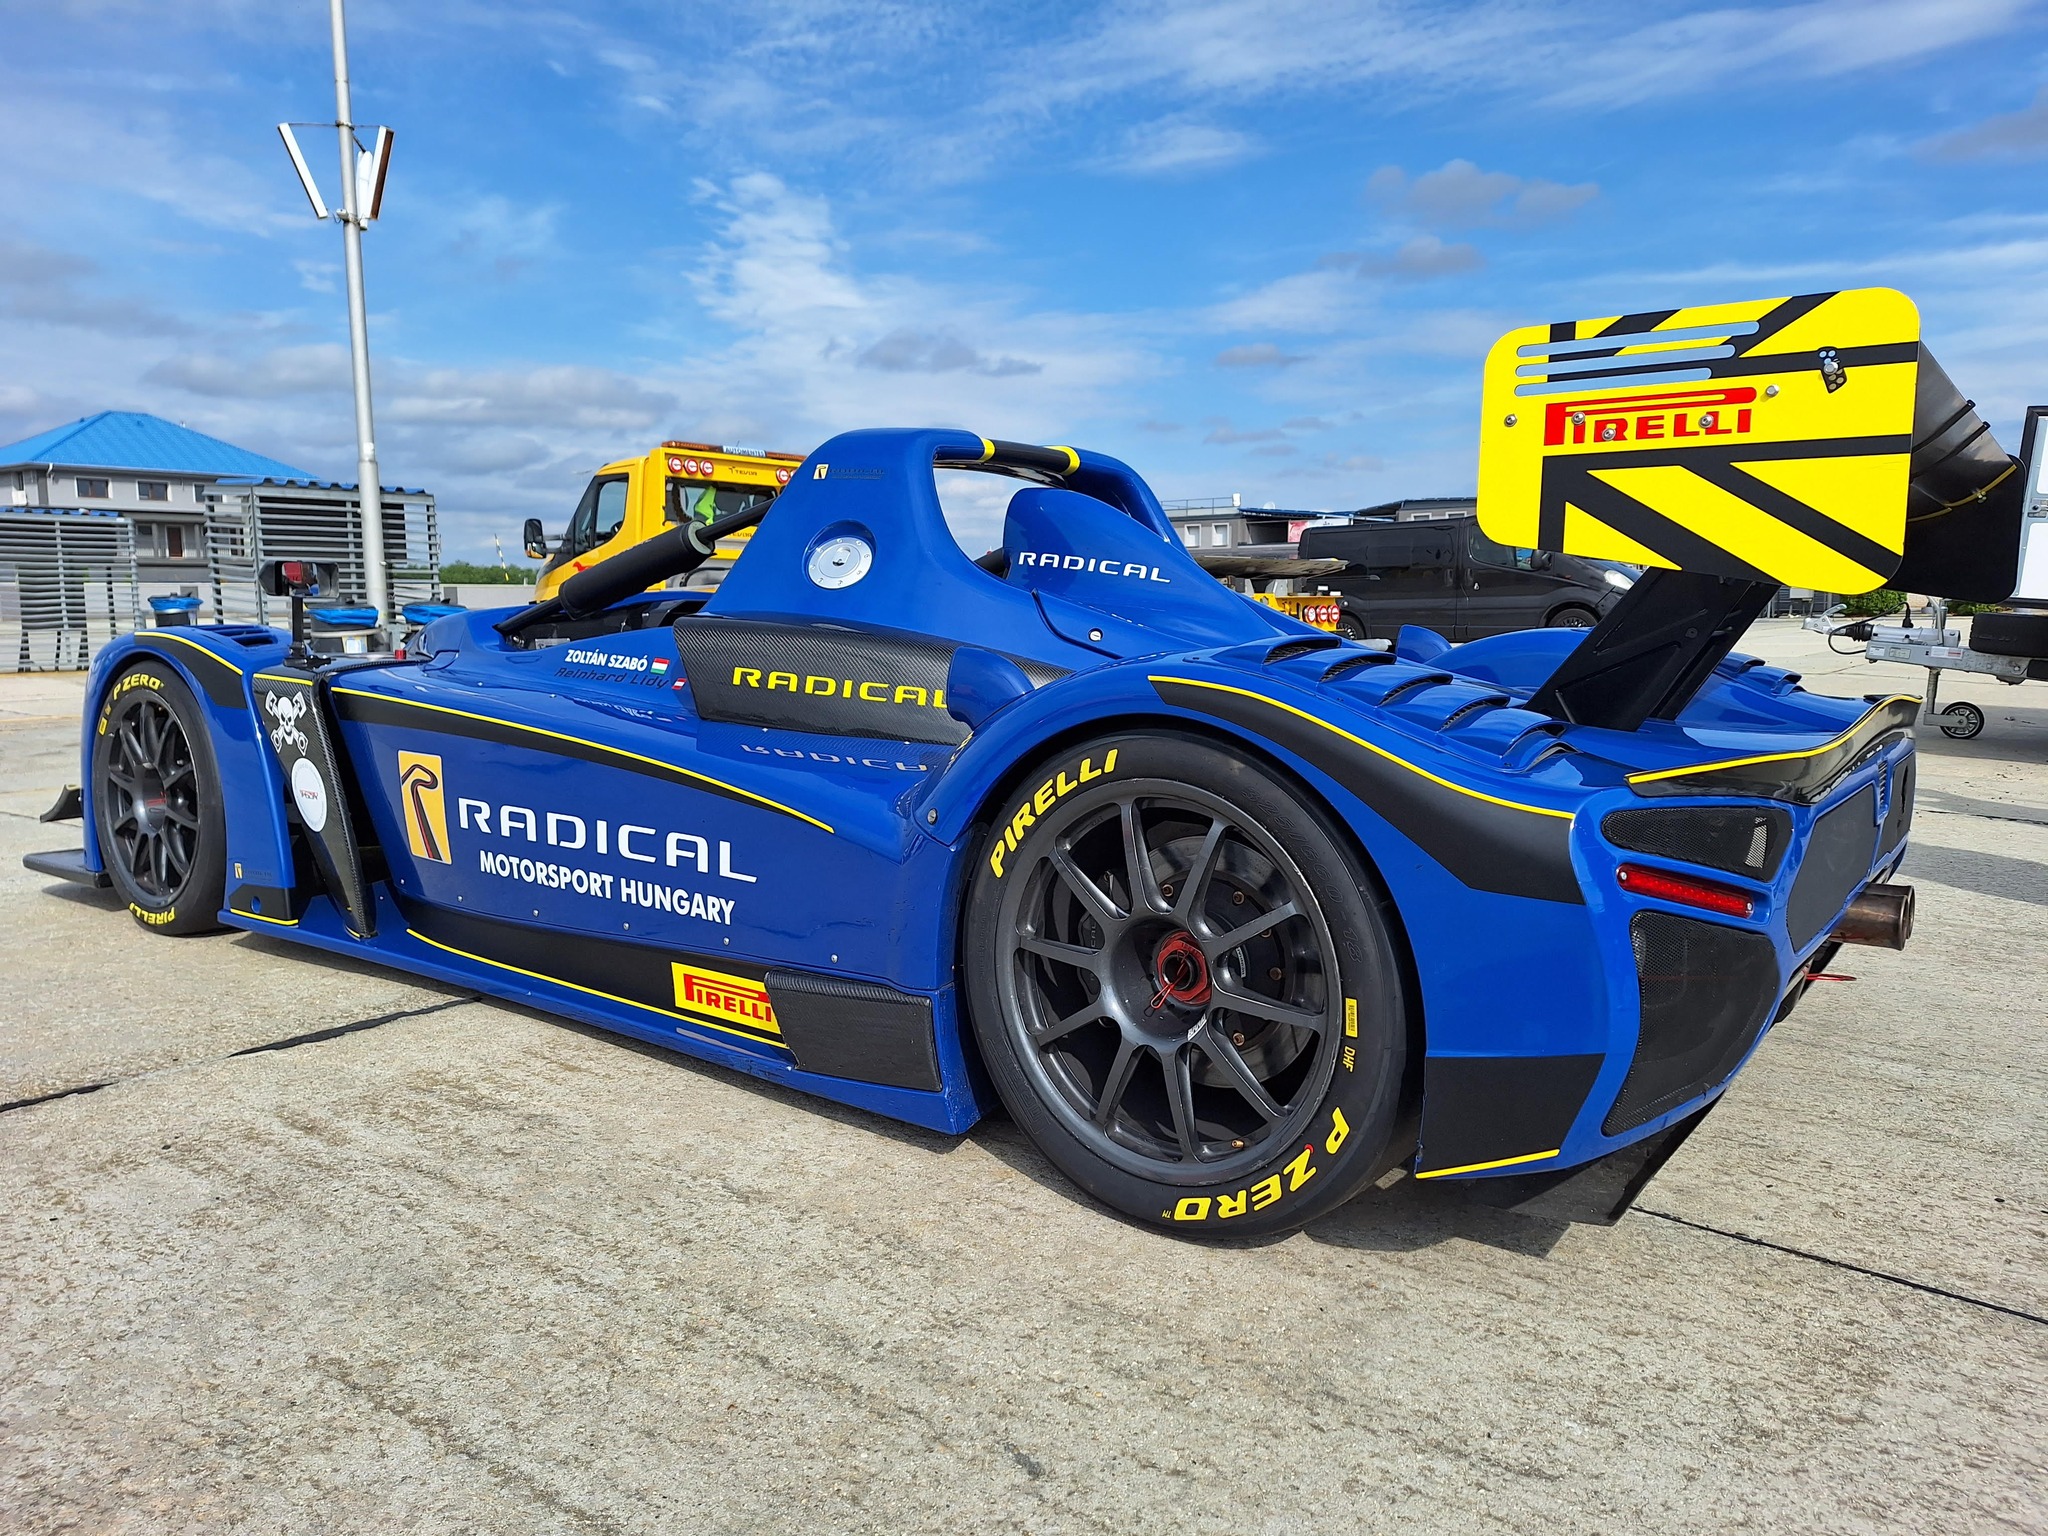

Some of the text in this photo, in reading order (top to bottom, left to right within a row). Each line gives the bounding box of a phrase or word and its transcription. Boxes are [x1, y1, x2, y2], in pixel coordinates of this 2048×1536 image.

[1544, 386, 1757, 446] PIRELLI
[1018, 552, 1171, 583] RADICAL
[565, 649, 648, 672] ZOLTÁN SZABÓ
[113, 673, 161, 700] P ZERO
[990, 749, 1118, 878] PIRELLI
[458, 797, 757, 883] RADICAL
[480, 850, 735, 925] MOTORSPORT HUNGARY
[129, 902, 175, 925] PIRELLI
[683, 973, 771, 1022] PIRELLI
[1342, 1045, 1356, 1073] DHF
[1326, 1106, 1350, 1154] P
[1174, 1149, 1317, 1221] ZERO
